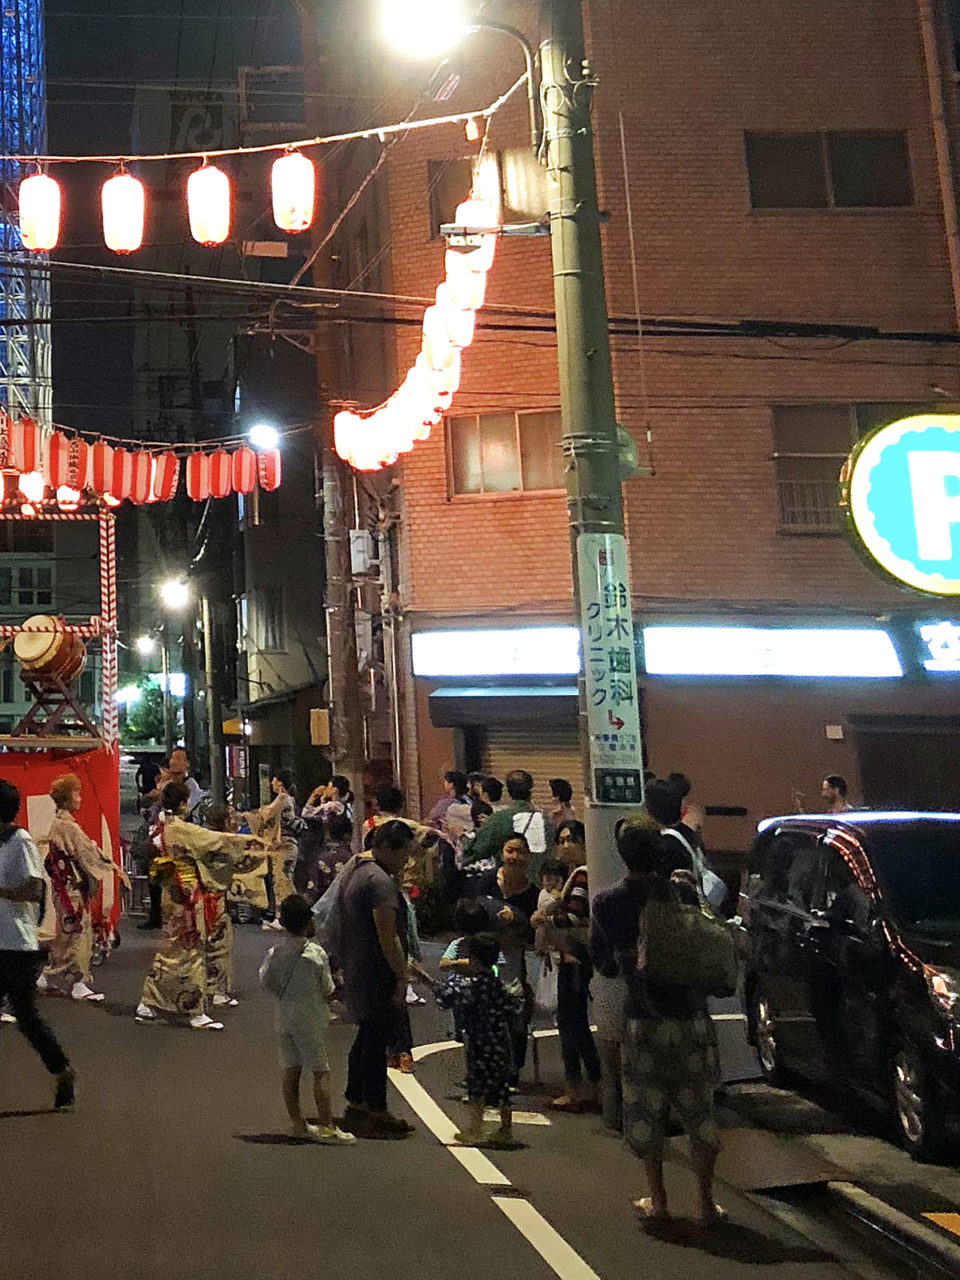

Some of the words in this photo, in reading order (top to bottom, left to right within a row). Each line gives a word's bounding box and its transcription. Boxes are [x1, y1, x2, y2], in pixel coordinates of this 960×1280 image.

[586, 602, 607, 706] クリニック
[603, 581, 634, 707] 鈴木歯科
